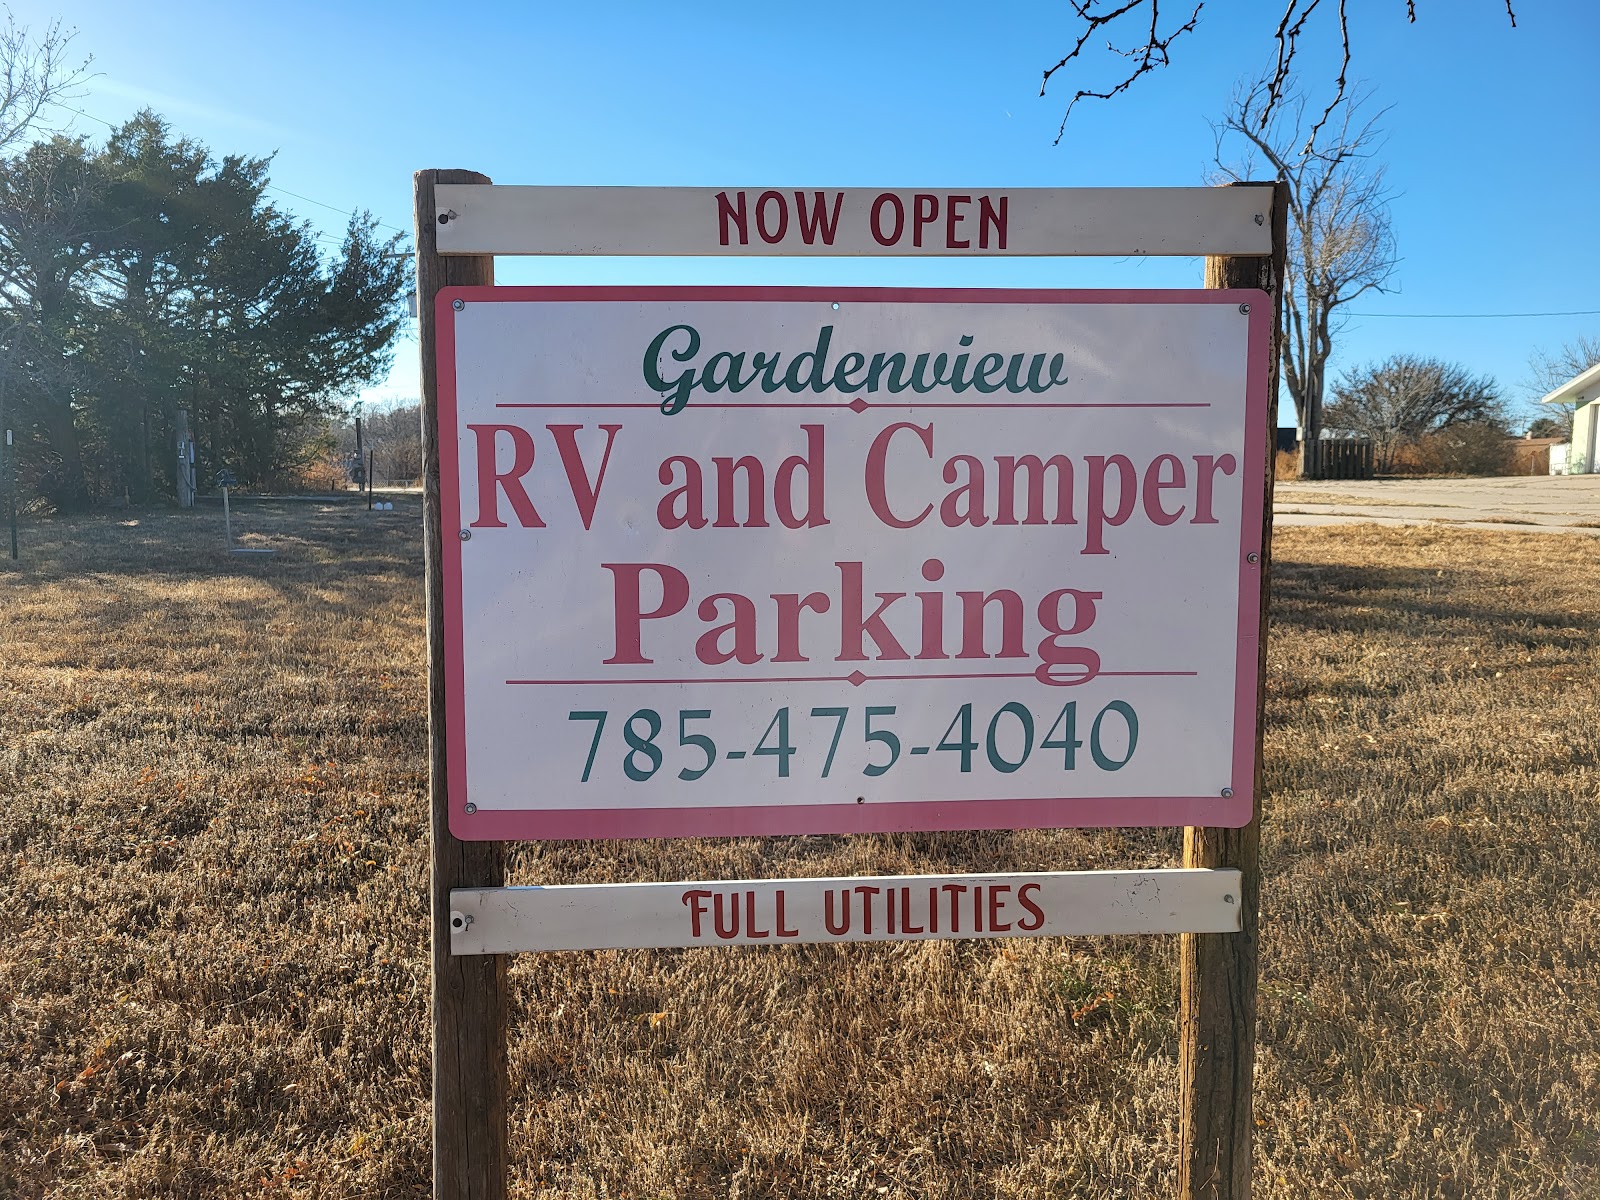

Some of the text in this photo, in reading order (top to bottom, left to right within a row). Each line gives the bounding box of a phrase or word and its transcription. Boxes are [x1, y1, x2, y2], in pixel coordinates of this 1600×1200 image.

[715, 191, 1009, 250] NOW OPEN
[642, 324, 1068, 416] Gardenview
[466, 421, 1237, 555] RV and Camper
[602, 558, 1103, 687] Parking
[568, 700, 1139, 783] 785-475-4040
[682, 883, 1045, 939] FULL UTILITIES
